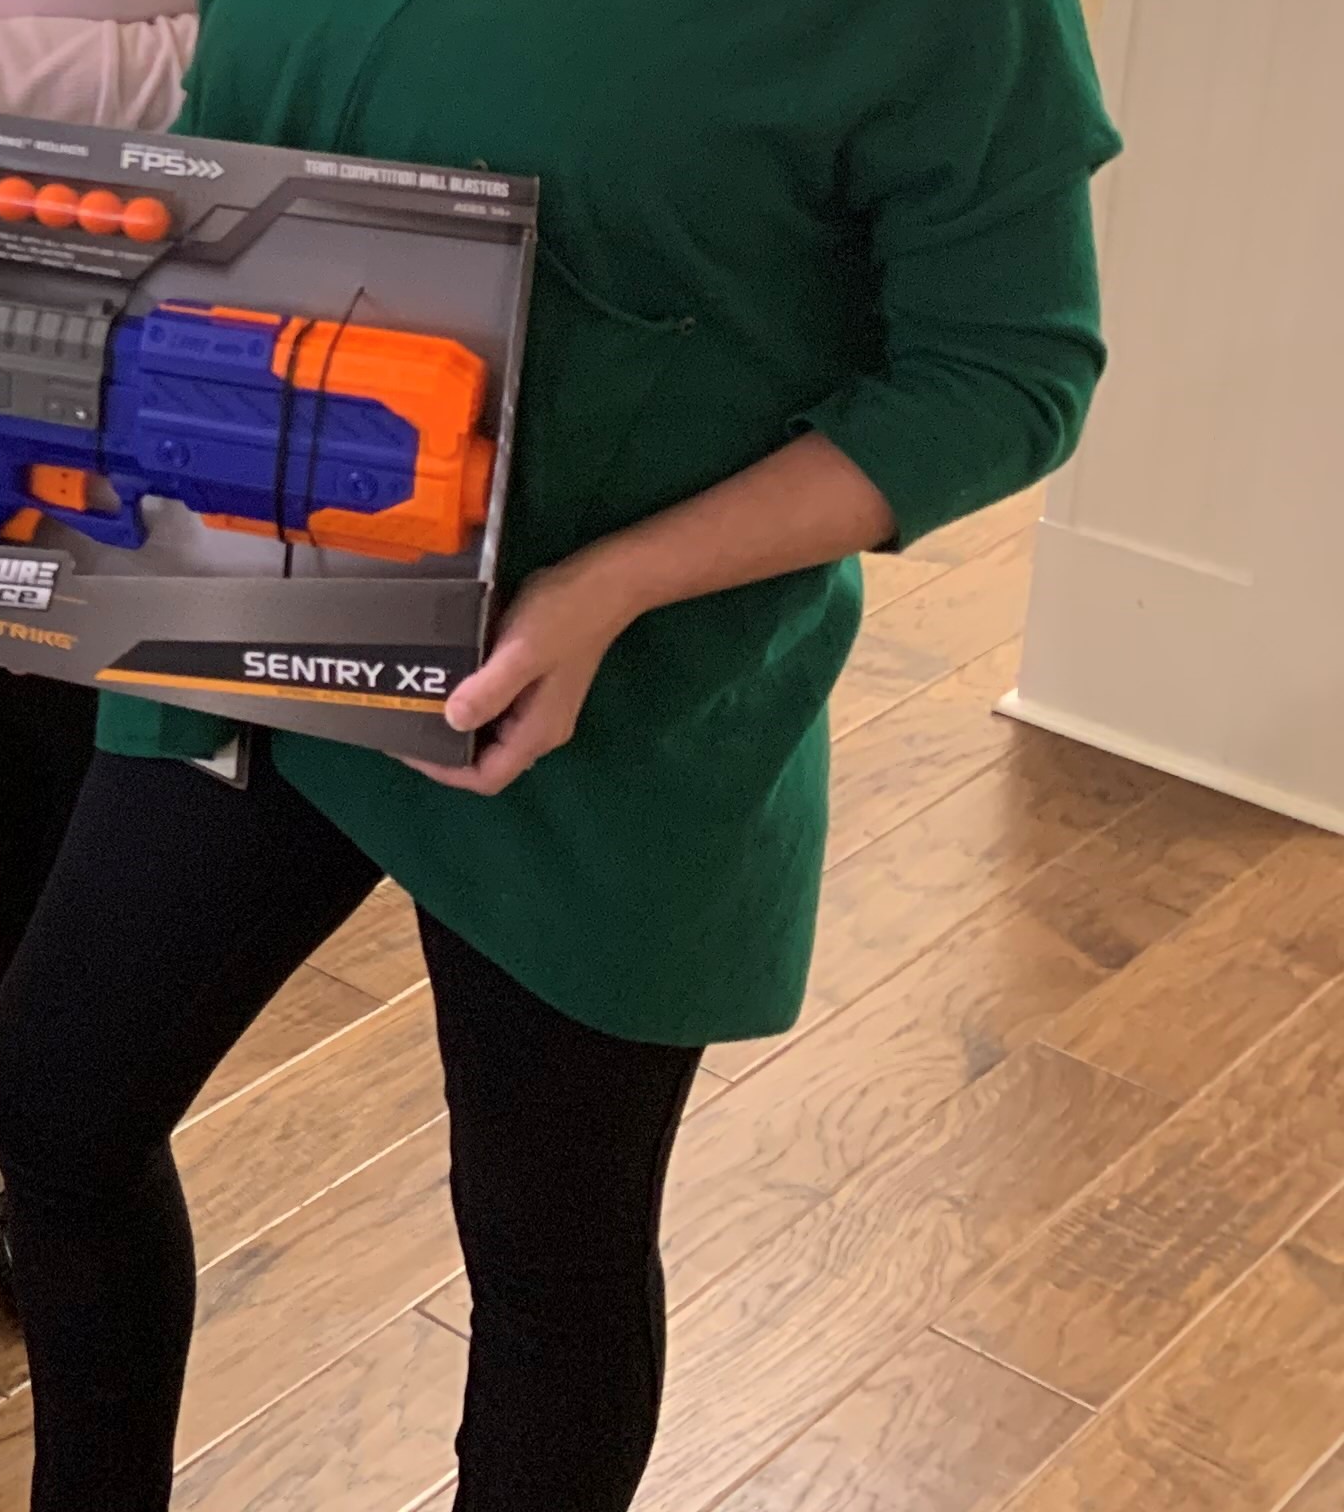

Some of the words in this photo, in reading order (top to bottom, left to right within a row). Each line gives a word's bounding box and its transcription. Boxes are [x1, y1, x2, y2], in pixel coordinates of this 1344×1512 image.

[119, 149, 187, 176] FPS
[305, 159, 337, 176] TEAM
[340, 163, 417, 187] COMPETITION
[419, 172, 447, 190] BALL
[449, 176, 510, 198] BLASTERS
[243, 651, 384, 688] SENTRY
[396, 664, 448, 694] X2
